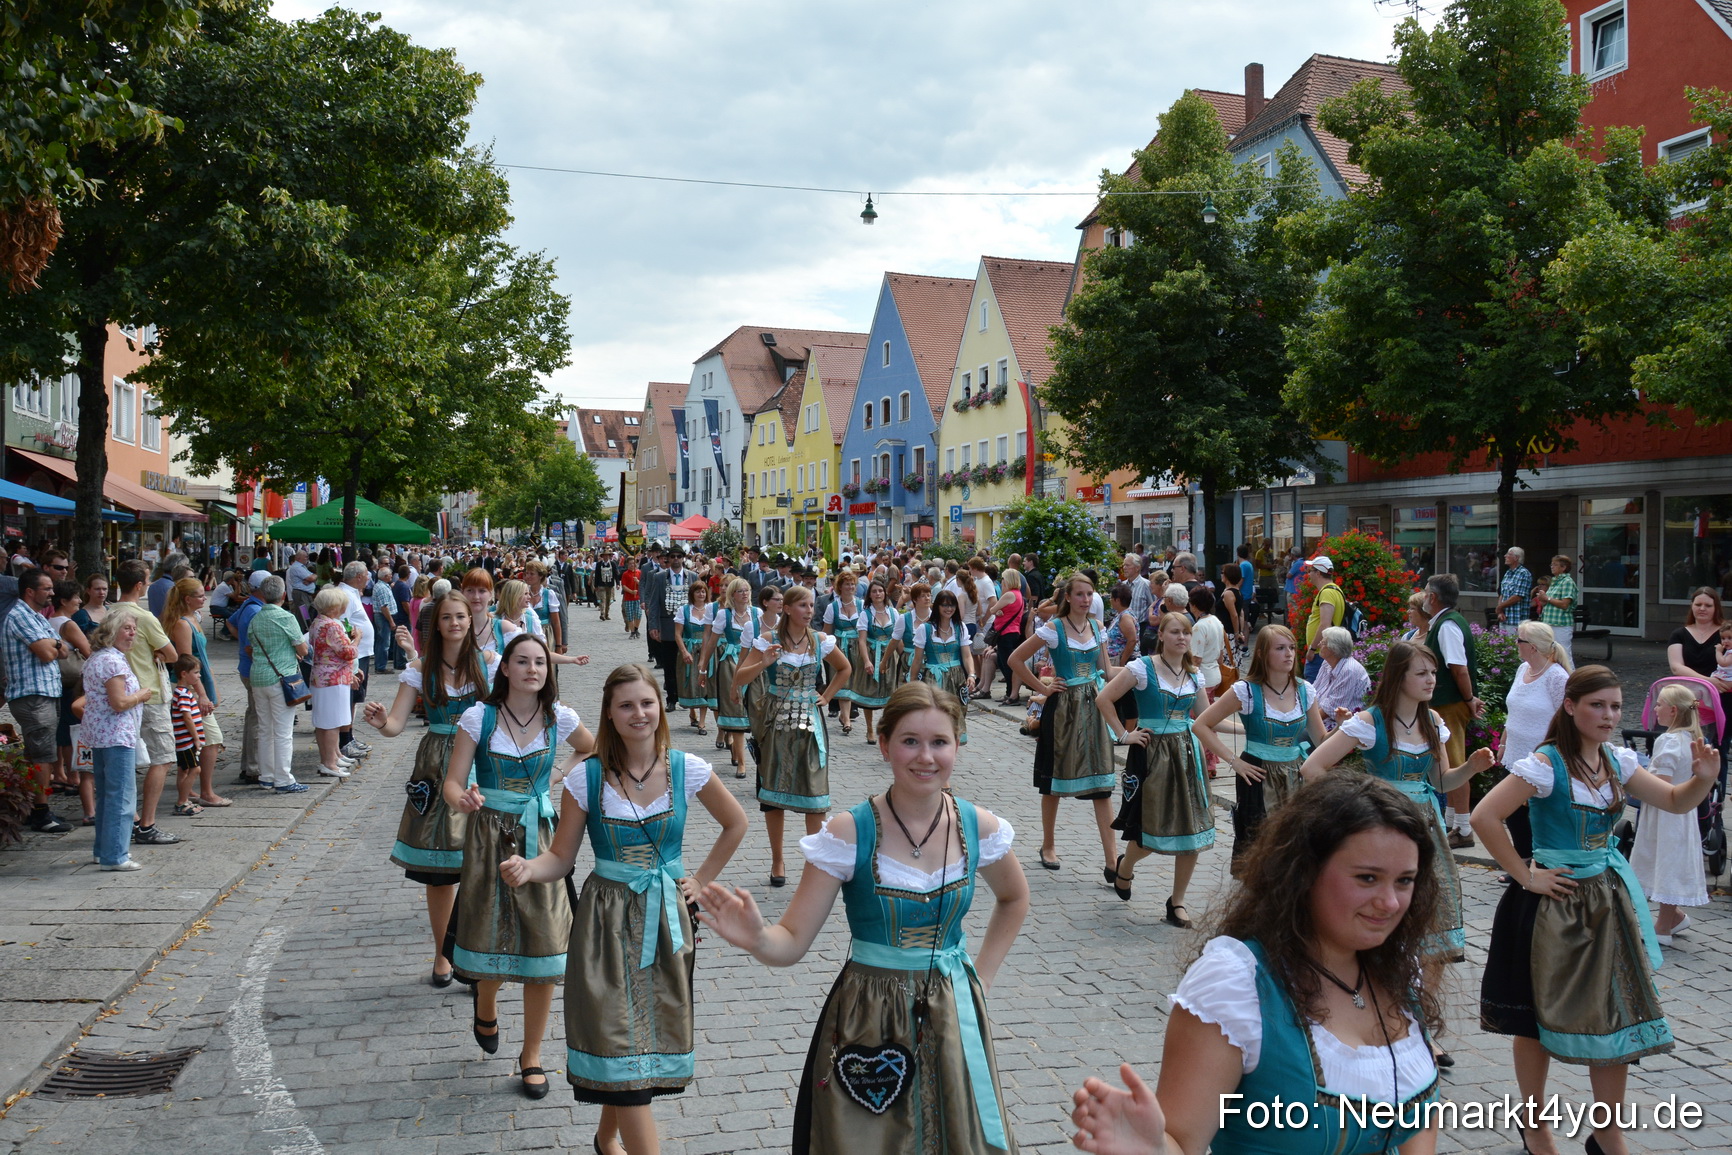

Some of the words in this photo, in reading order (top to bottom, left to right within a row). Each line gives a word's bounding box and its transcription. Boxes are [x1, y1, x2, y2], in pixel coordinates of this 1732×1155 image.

[1487, 430, 1555, 457] TKO
[1592, 426, 1668, 456] JOSEF
[1680, 418, 1732, 449] ZEI
[952, 507, 960, 521] P
[82, 751, 91, 760] M
